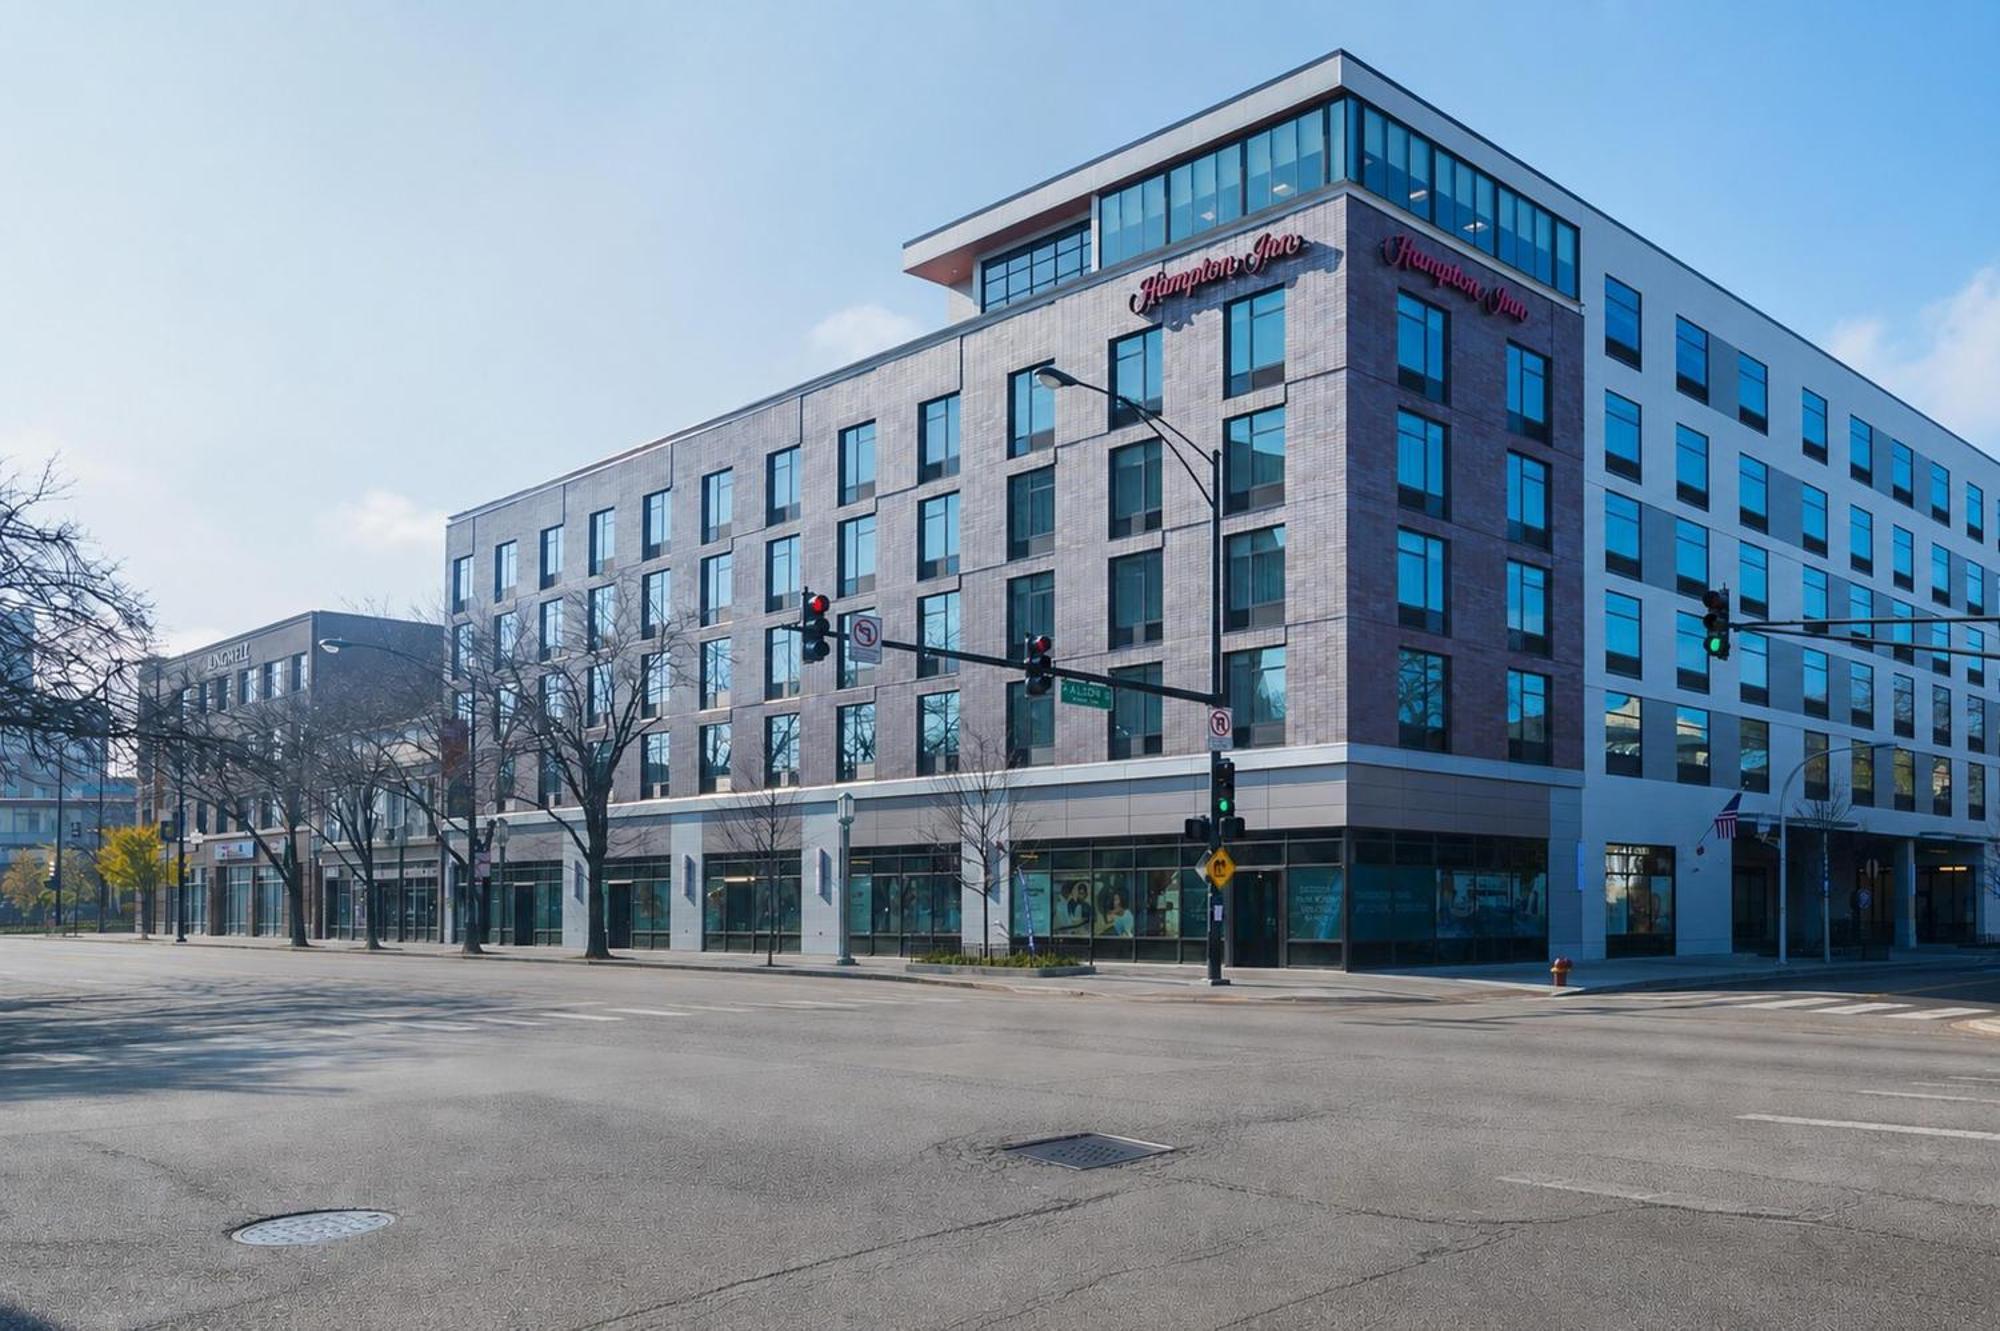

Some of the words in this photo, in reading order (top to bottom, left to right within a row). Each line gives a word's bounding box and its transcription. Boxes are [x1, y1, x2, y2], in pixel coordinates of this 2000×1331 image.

[1129, 255, 1241, 314] Hampton
[1242, 232, 1306, 275] Inn
[1384, 232, 1487, 302] Hampton
[1486, 286, 1528, 322] Inn
